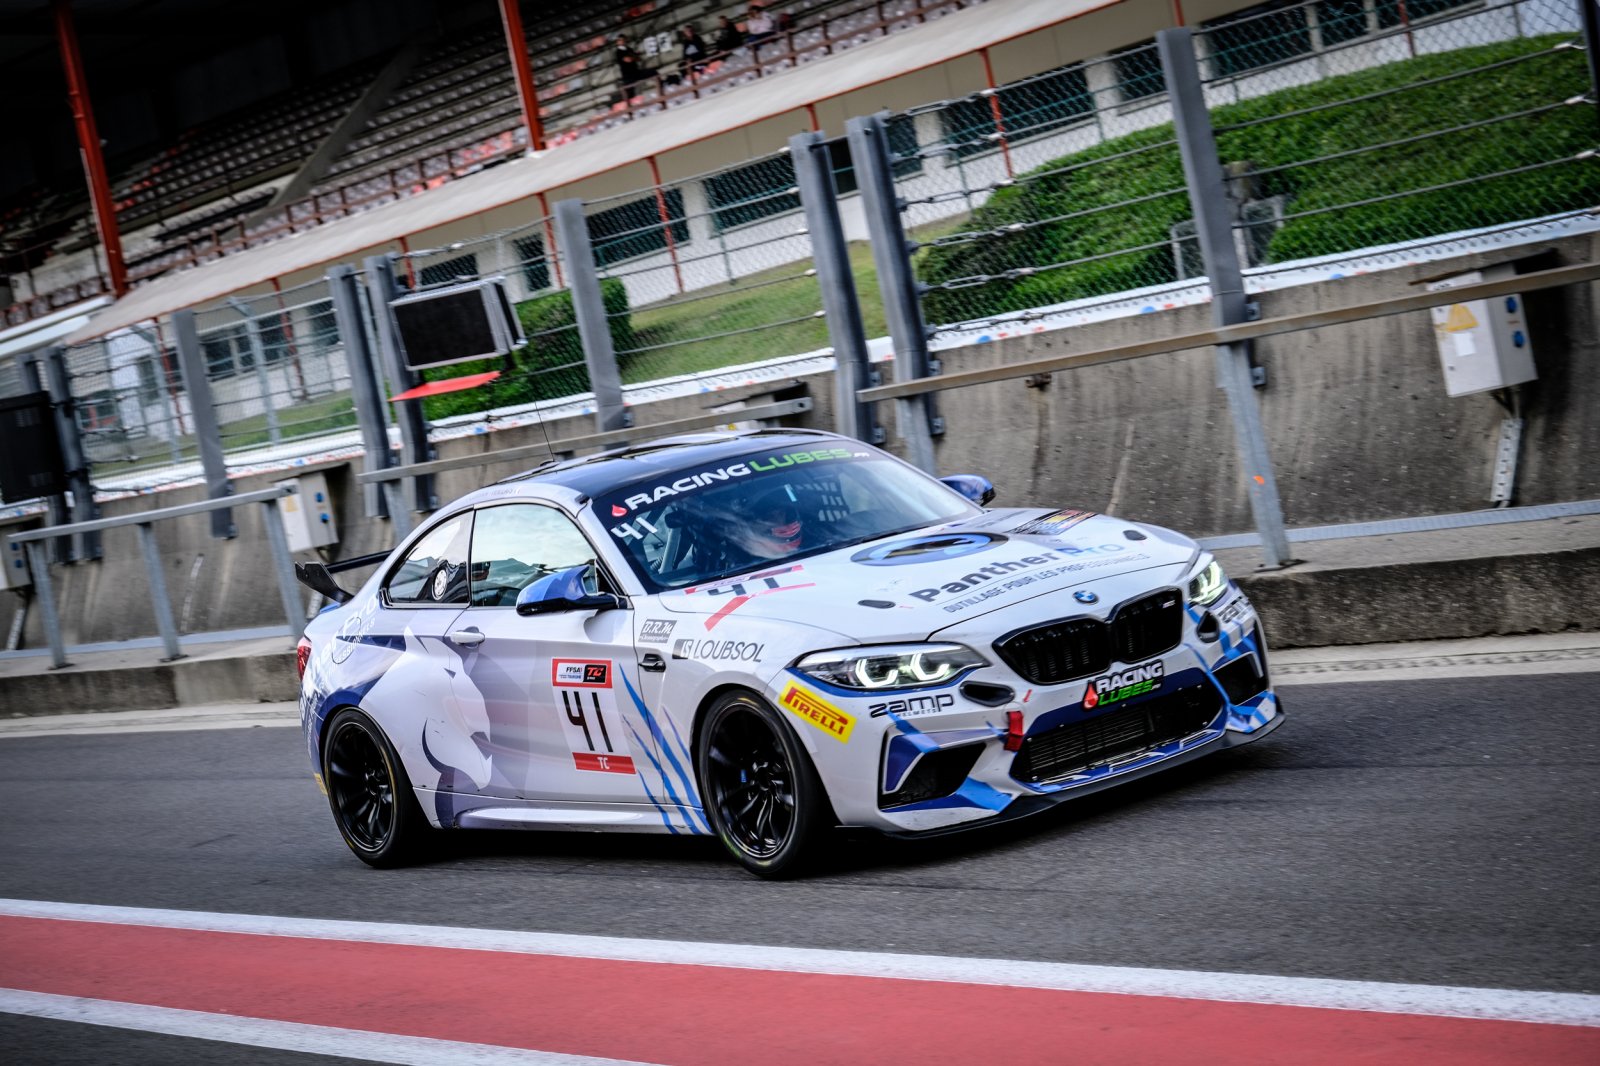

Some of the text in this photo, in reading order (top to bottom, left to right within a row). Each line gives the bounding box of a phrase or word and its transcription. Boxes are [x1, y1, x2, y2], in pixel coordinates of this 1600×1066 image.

[610, 516, 658, 540] 41
[943, 583, 1005, 613] OUTILLAGE
[1002, 575, 1039, 591] POUR
[693, 639, 765, 663] LOUBSOL
[566, 666, 581, 674] FFSA
[586, 667, 604, 677] TC
[1095, 661, 1162, 695] RACING
[1098, 678, 1155, 706] LUBES
[784, 686, 849, 736] PIRELLI
[868, 693, 955, 719] zamp
[561, 690, 614, 753] 41
[597, 756, 611, 770] TC
